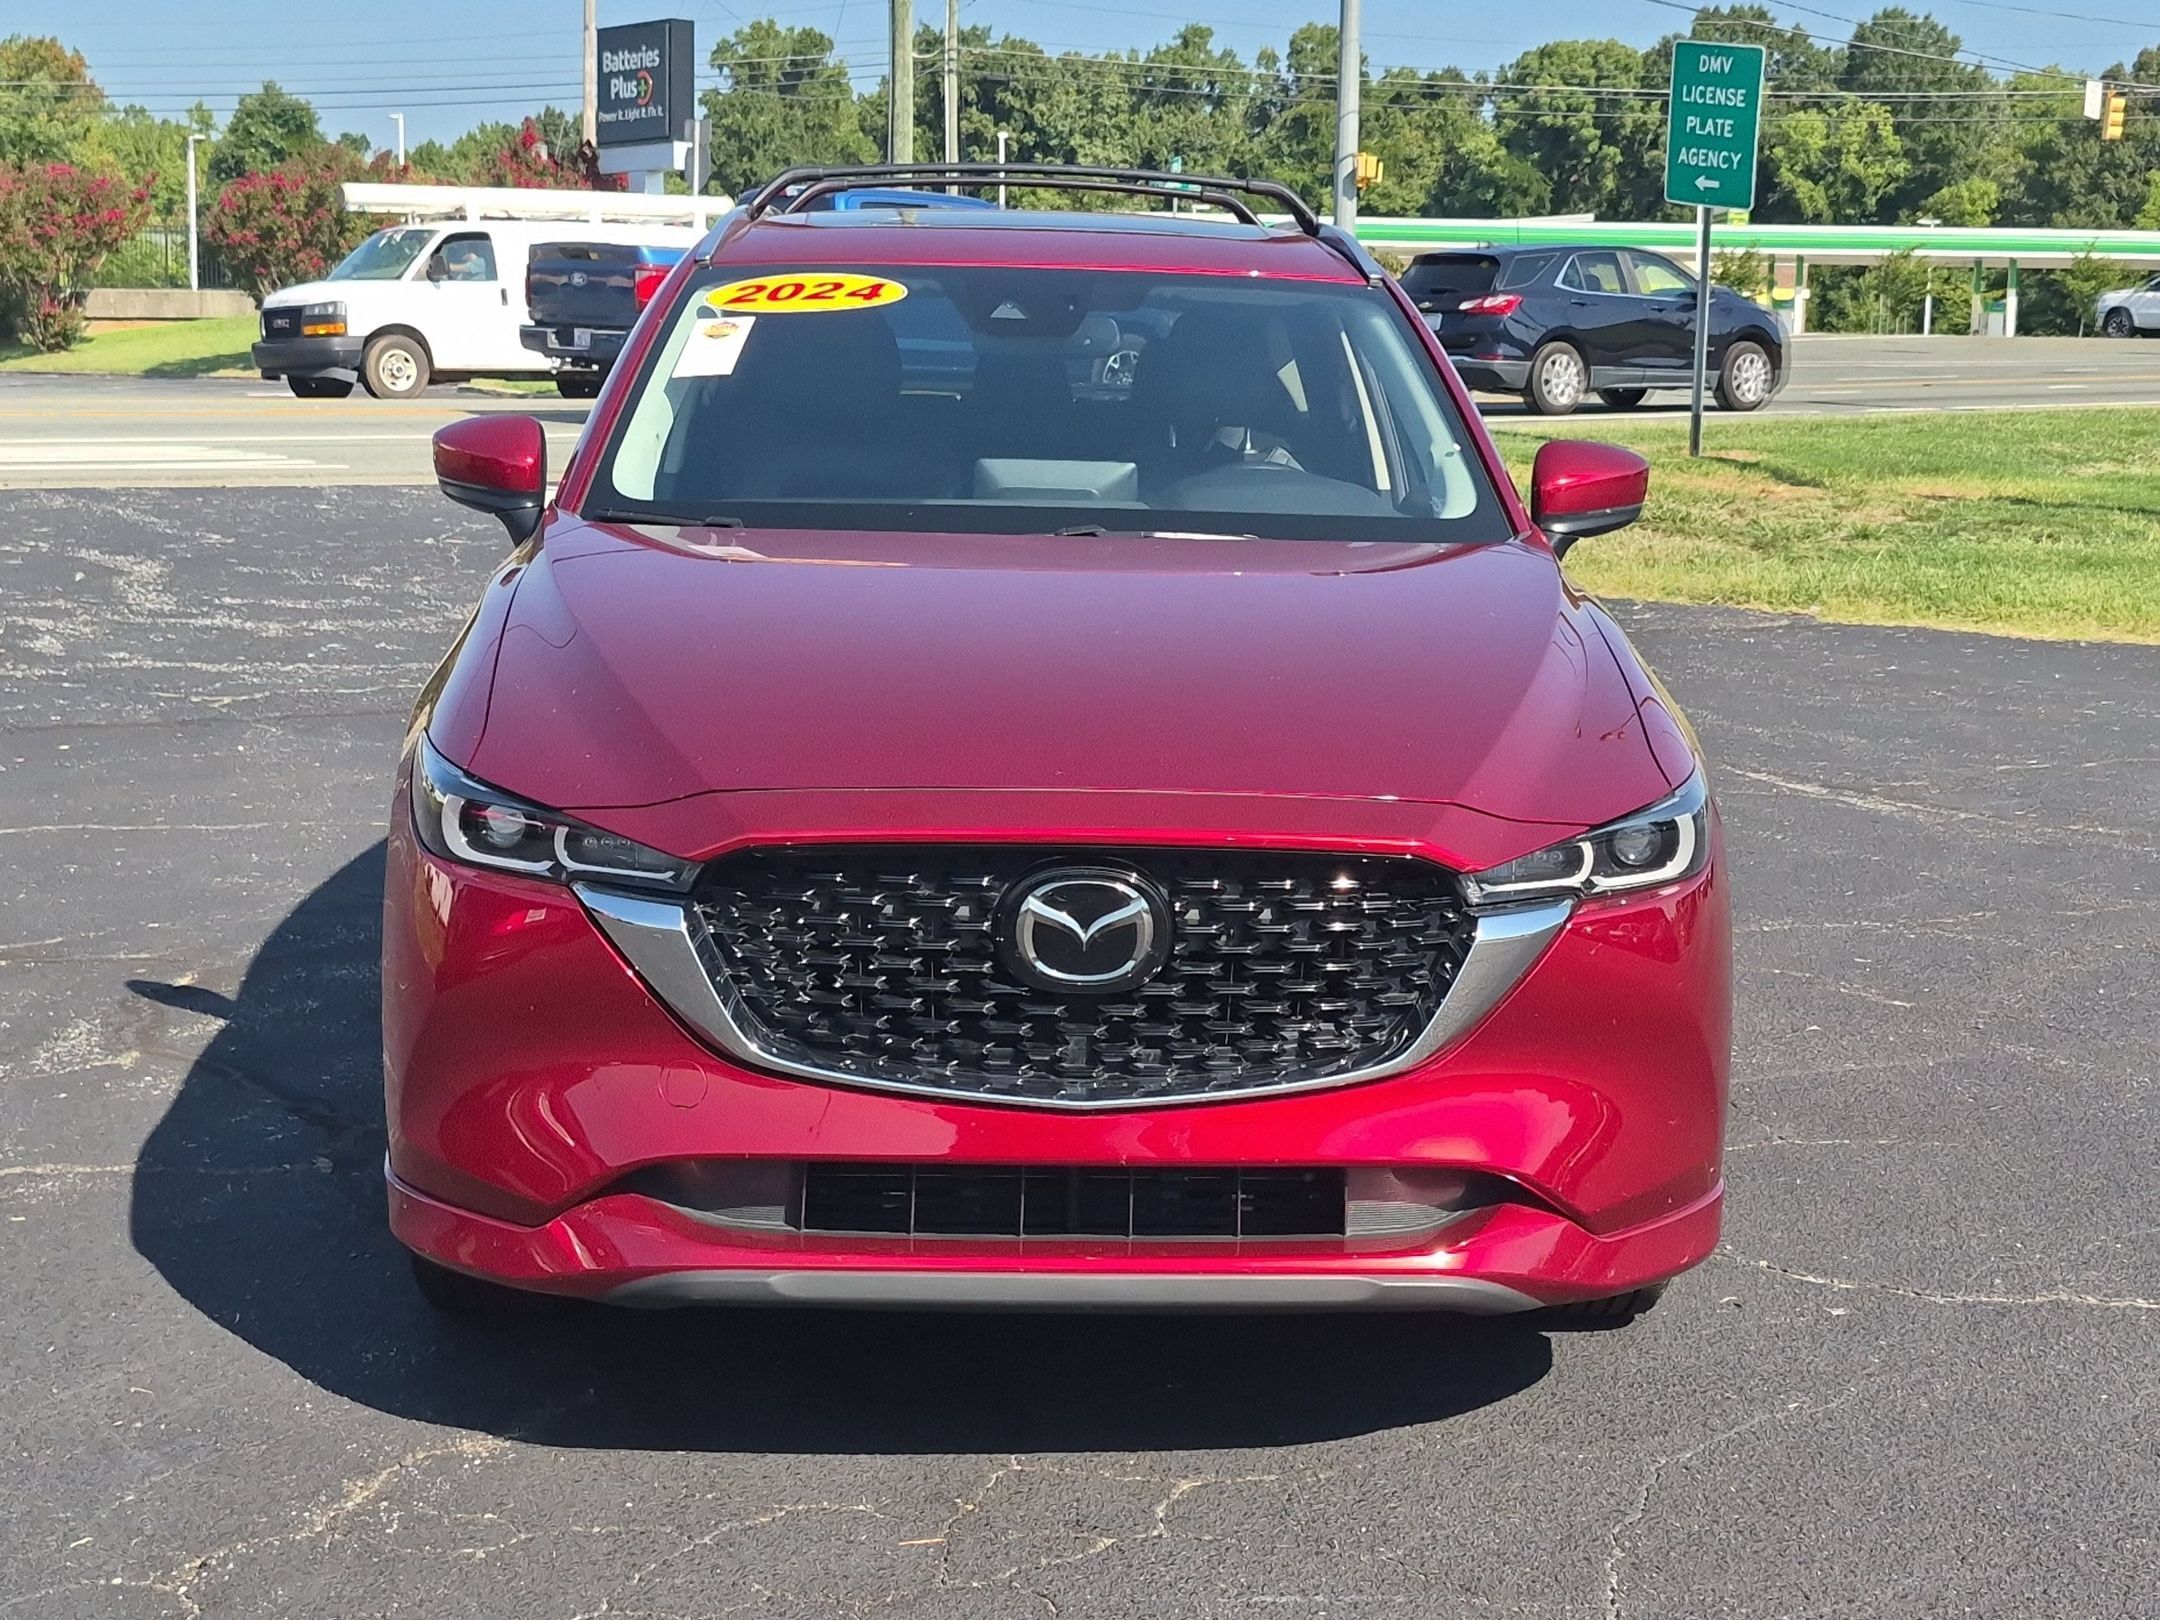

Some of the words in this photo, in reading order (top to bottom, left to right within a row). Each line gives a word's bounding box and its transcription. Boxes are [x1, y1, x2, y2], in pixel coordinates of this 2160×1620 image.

[602, 45, 660, 73] Batteries
[1699, 54, 1734, 75] DMV
[610, 75, 638, 100] Plus
[1682, 84, 1746, 107] LICENSE
[1686, 115, 1735, 138] PLATE
[1677, 146, 1742, 171] AGENCY
[723, 282, 887, 304] 2024
